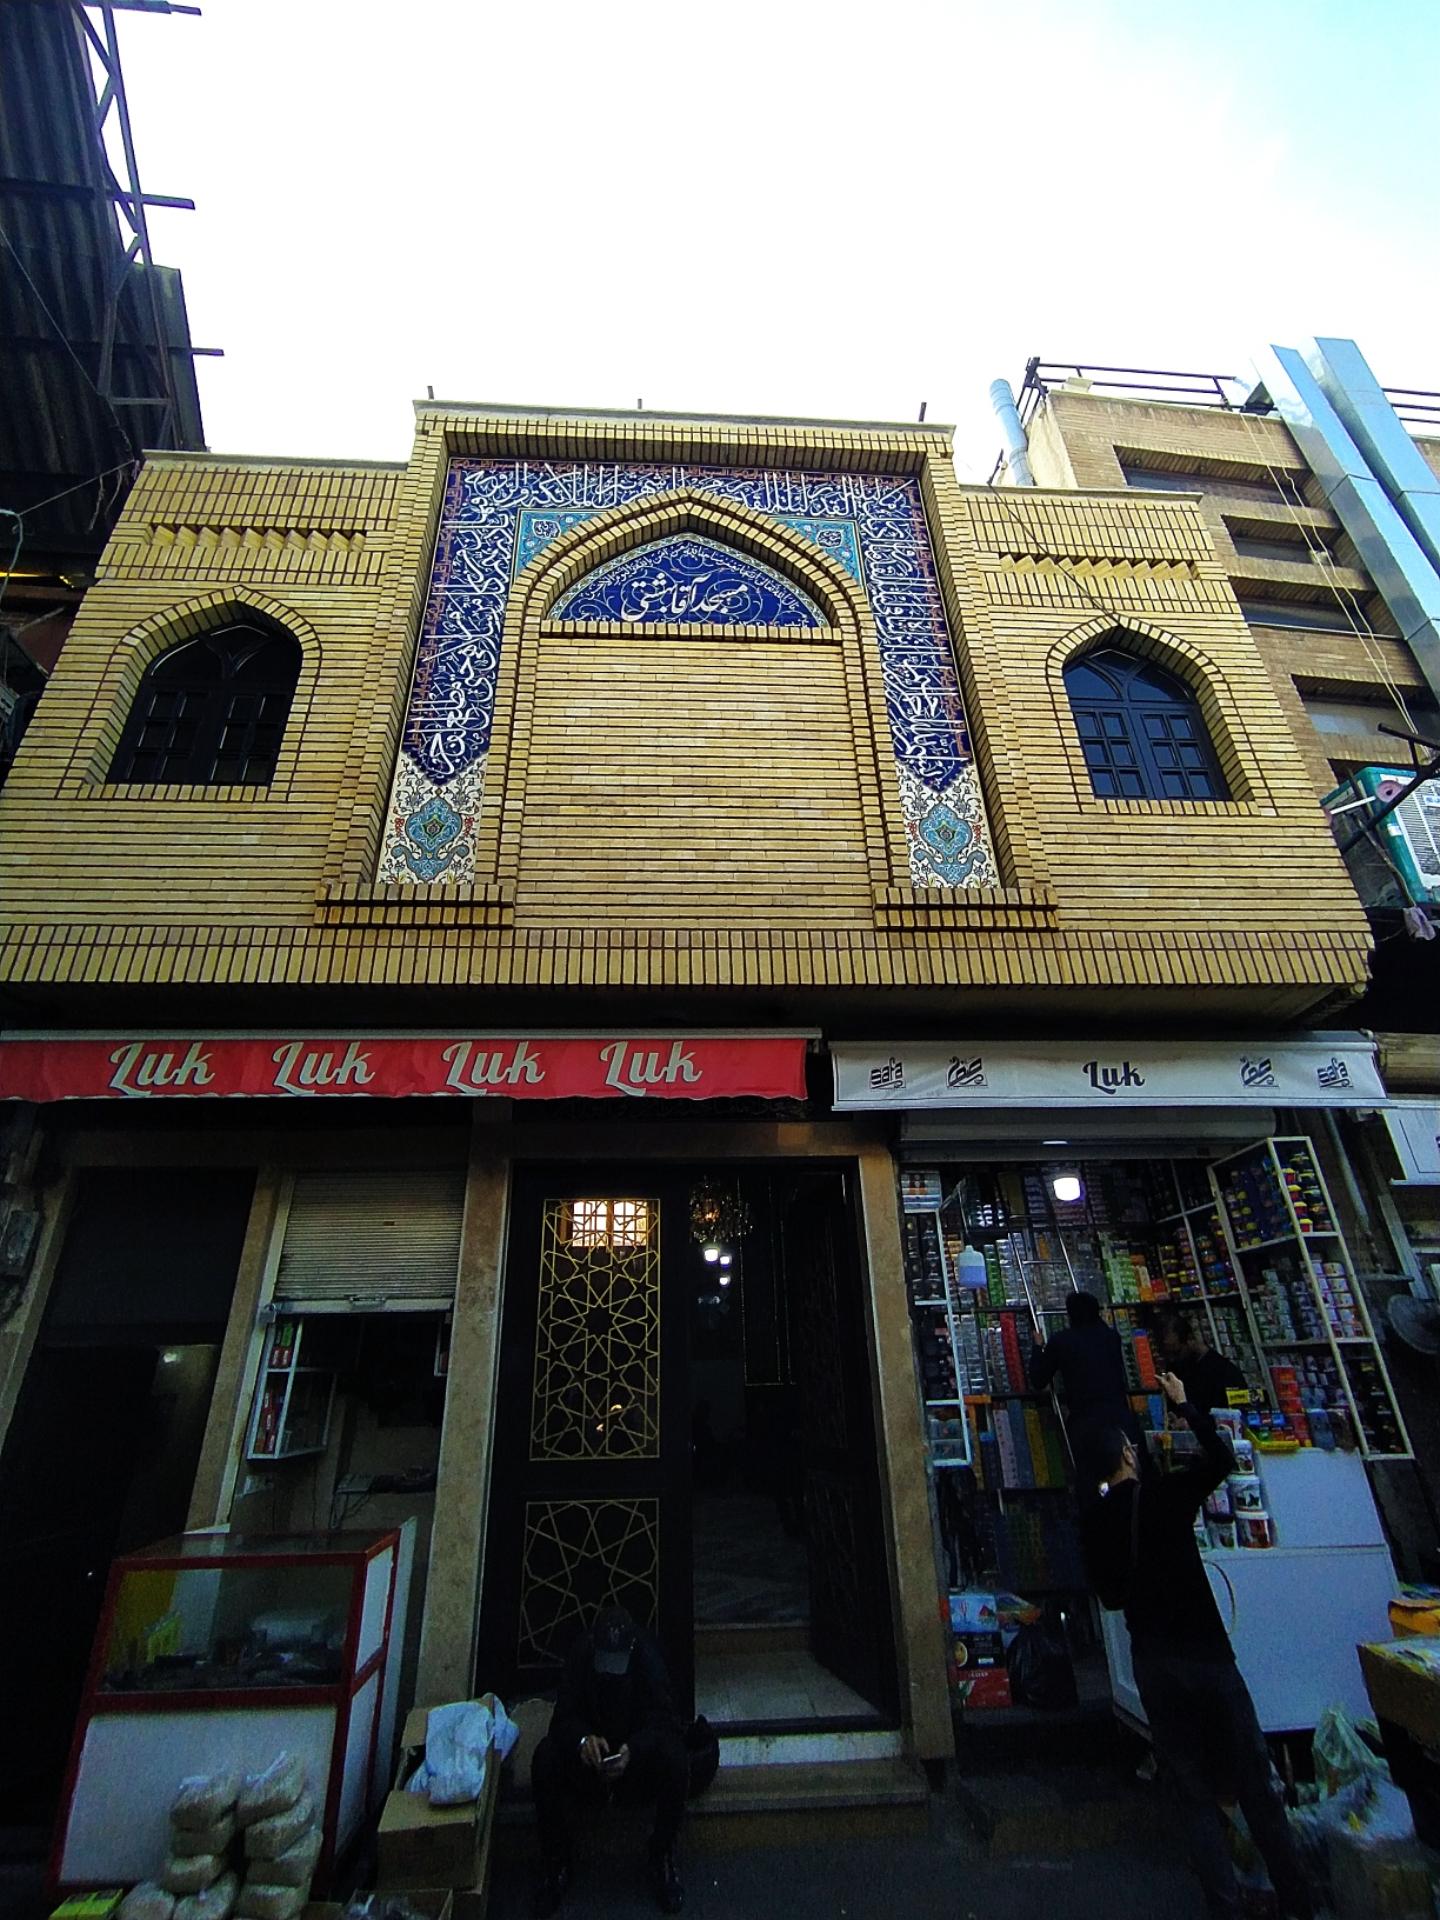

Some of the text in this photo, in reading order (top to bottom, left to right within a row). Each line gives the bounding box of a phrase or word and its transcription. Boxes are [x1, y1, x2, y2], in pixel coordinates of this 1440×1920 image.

[689, 584, 749, 614] مسجد
[107, 1041, 216, 1098] Luk
[271, 1041, 376, 1098] Luk
[441, 1041, 546, 1097] Luk
[599, 1041, 704, 1097] Luk
[1082, 1060, 1146, 1094] Luk
